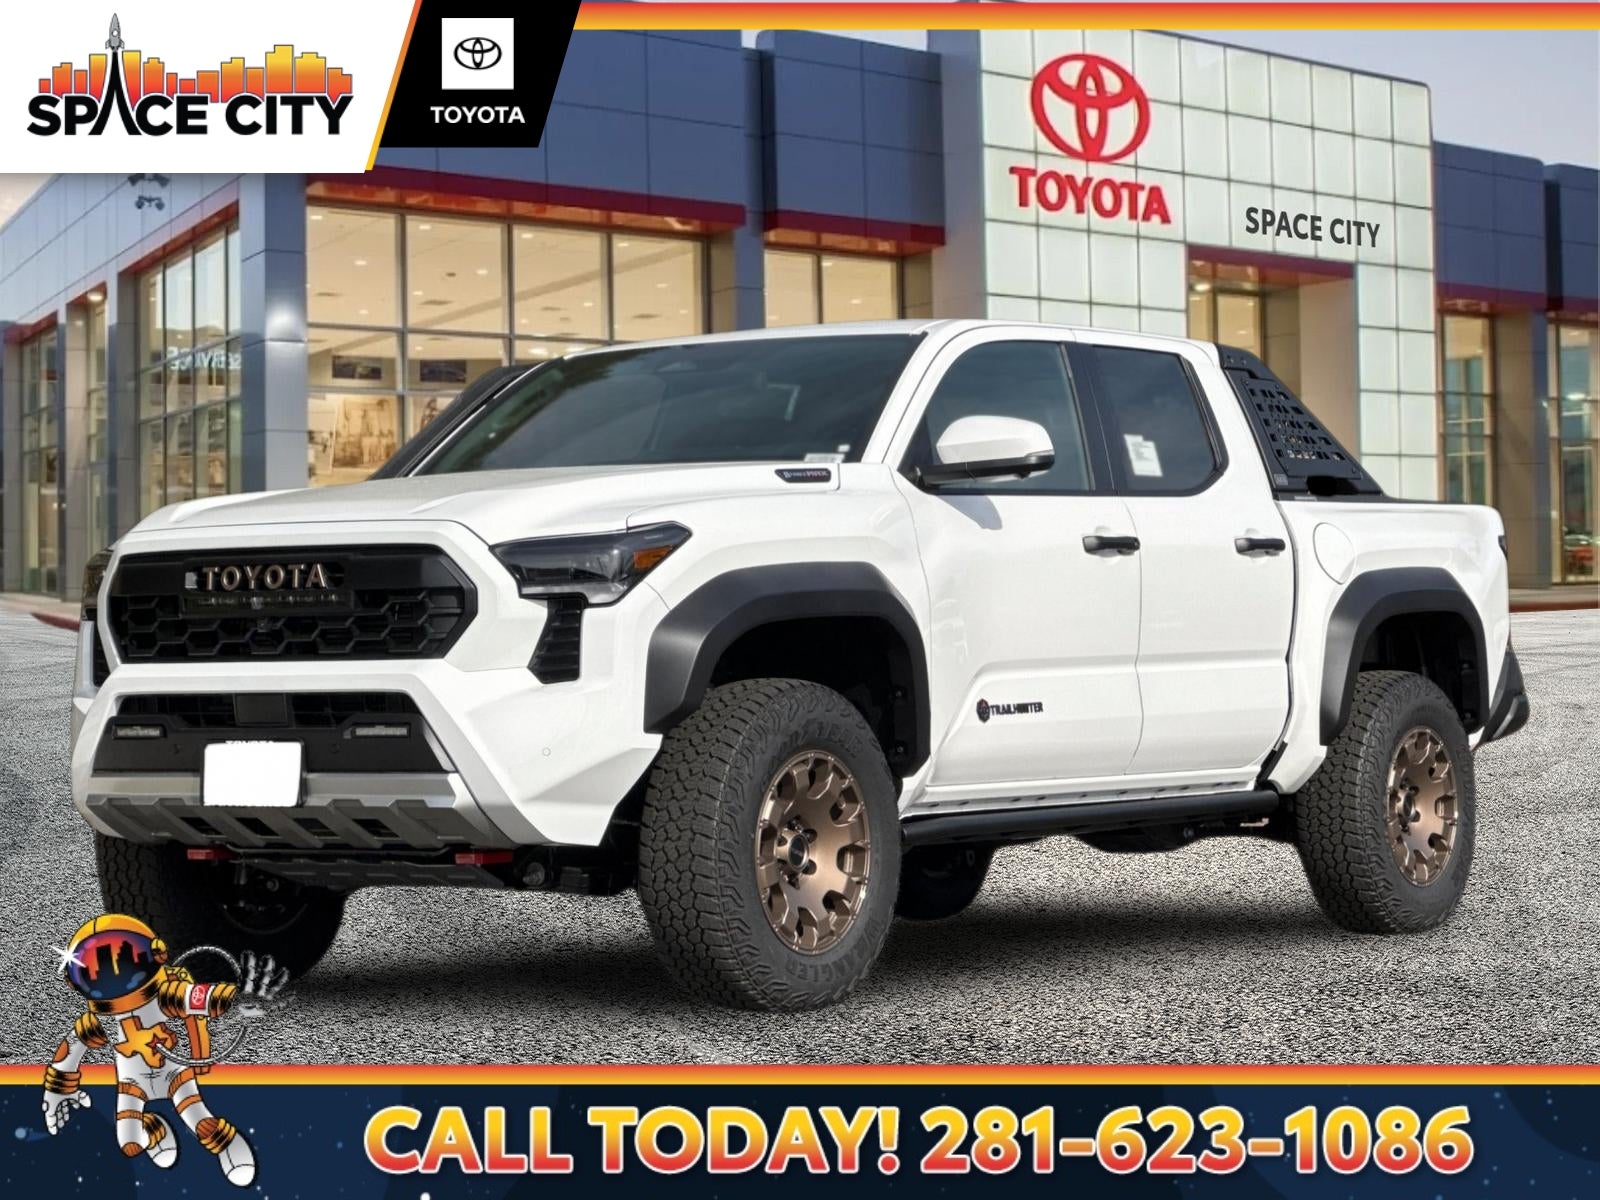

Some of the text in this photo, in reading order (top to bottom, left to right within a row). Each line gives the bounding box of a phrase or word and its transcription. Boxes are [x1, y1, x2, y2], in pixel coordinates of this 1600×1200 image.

[1009, 166, 1171, 225] TOYOTA
[1245, 206, 1381, 248] SPACE CITY
[202, 563, 328, 591] TOYOTA
